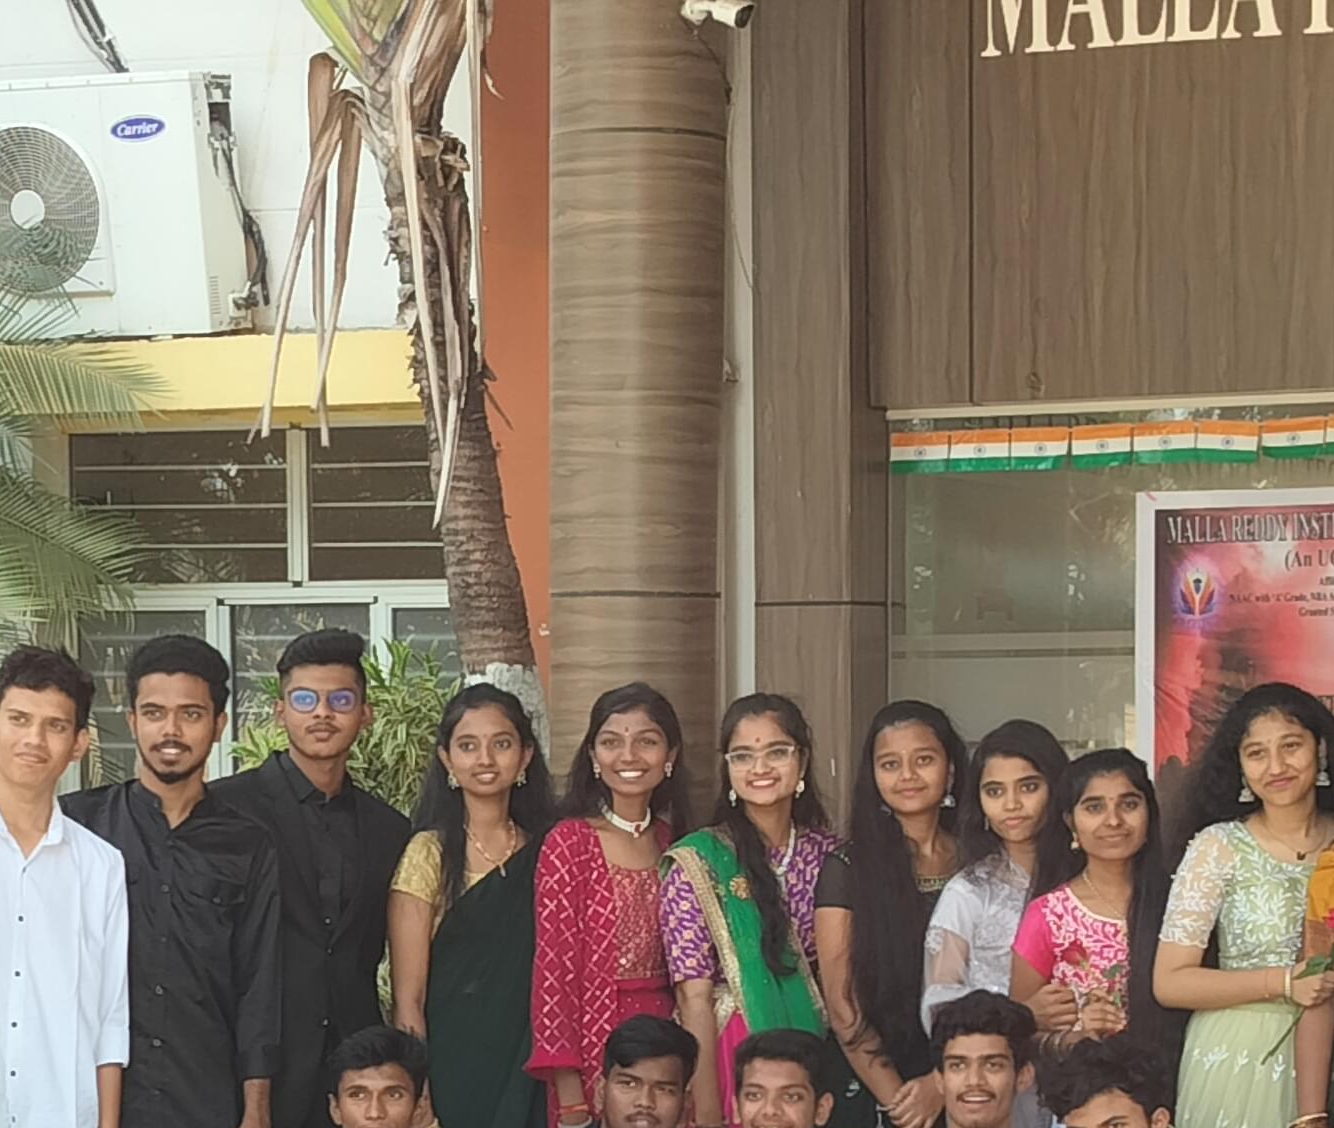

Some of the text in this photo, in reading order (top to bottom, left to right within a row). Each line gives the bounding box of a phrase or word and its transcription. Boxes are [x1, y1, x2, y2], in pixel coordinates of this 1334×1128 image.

[116, 121, 159, 137] Carrier
[1167, 515, 1228, 544] MALLA
[1231, 514, 1288, 542] REDDY
[1284, 549, 1312, 572] (An
